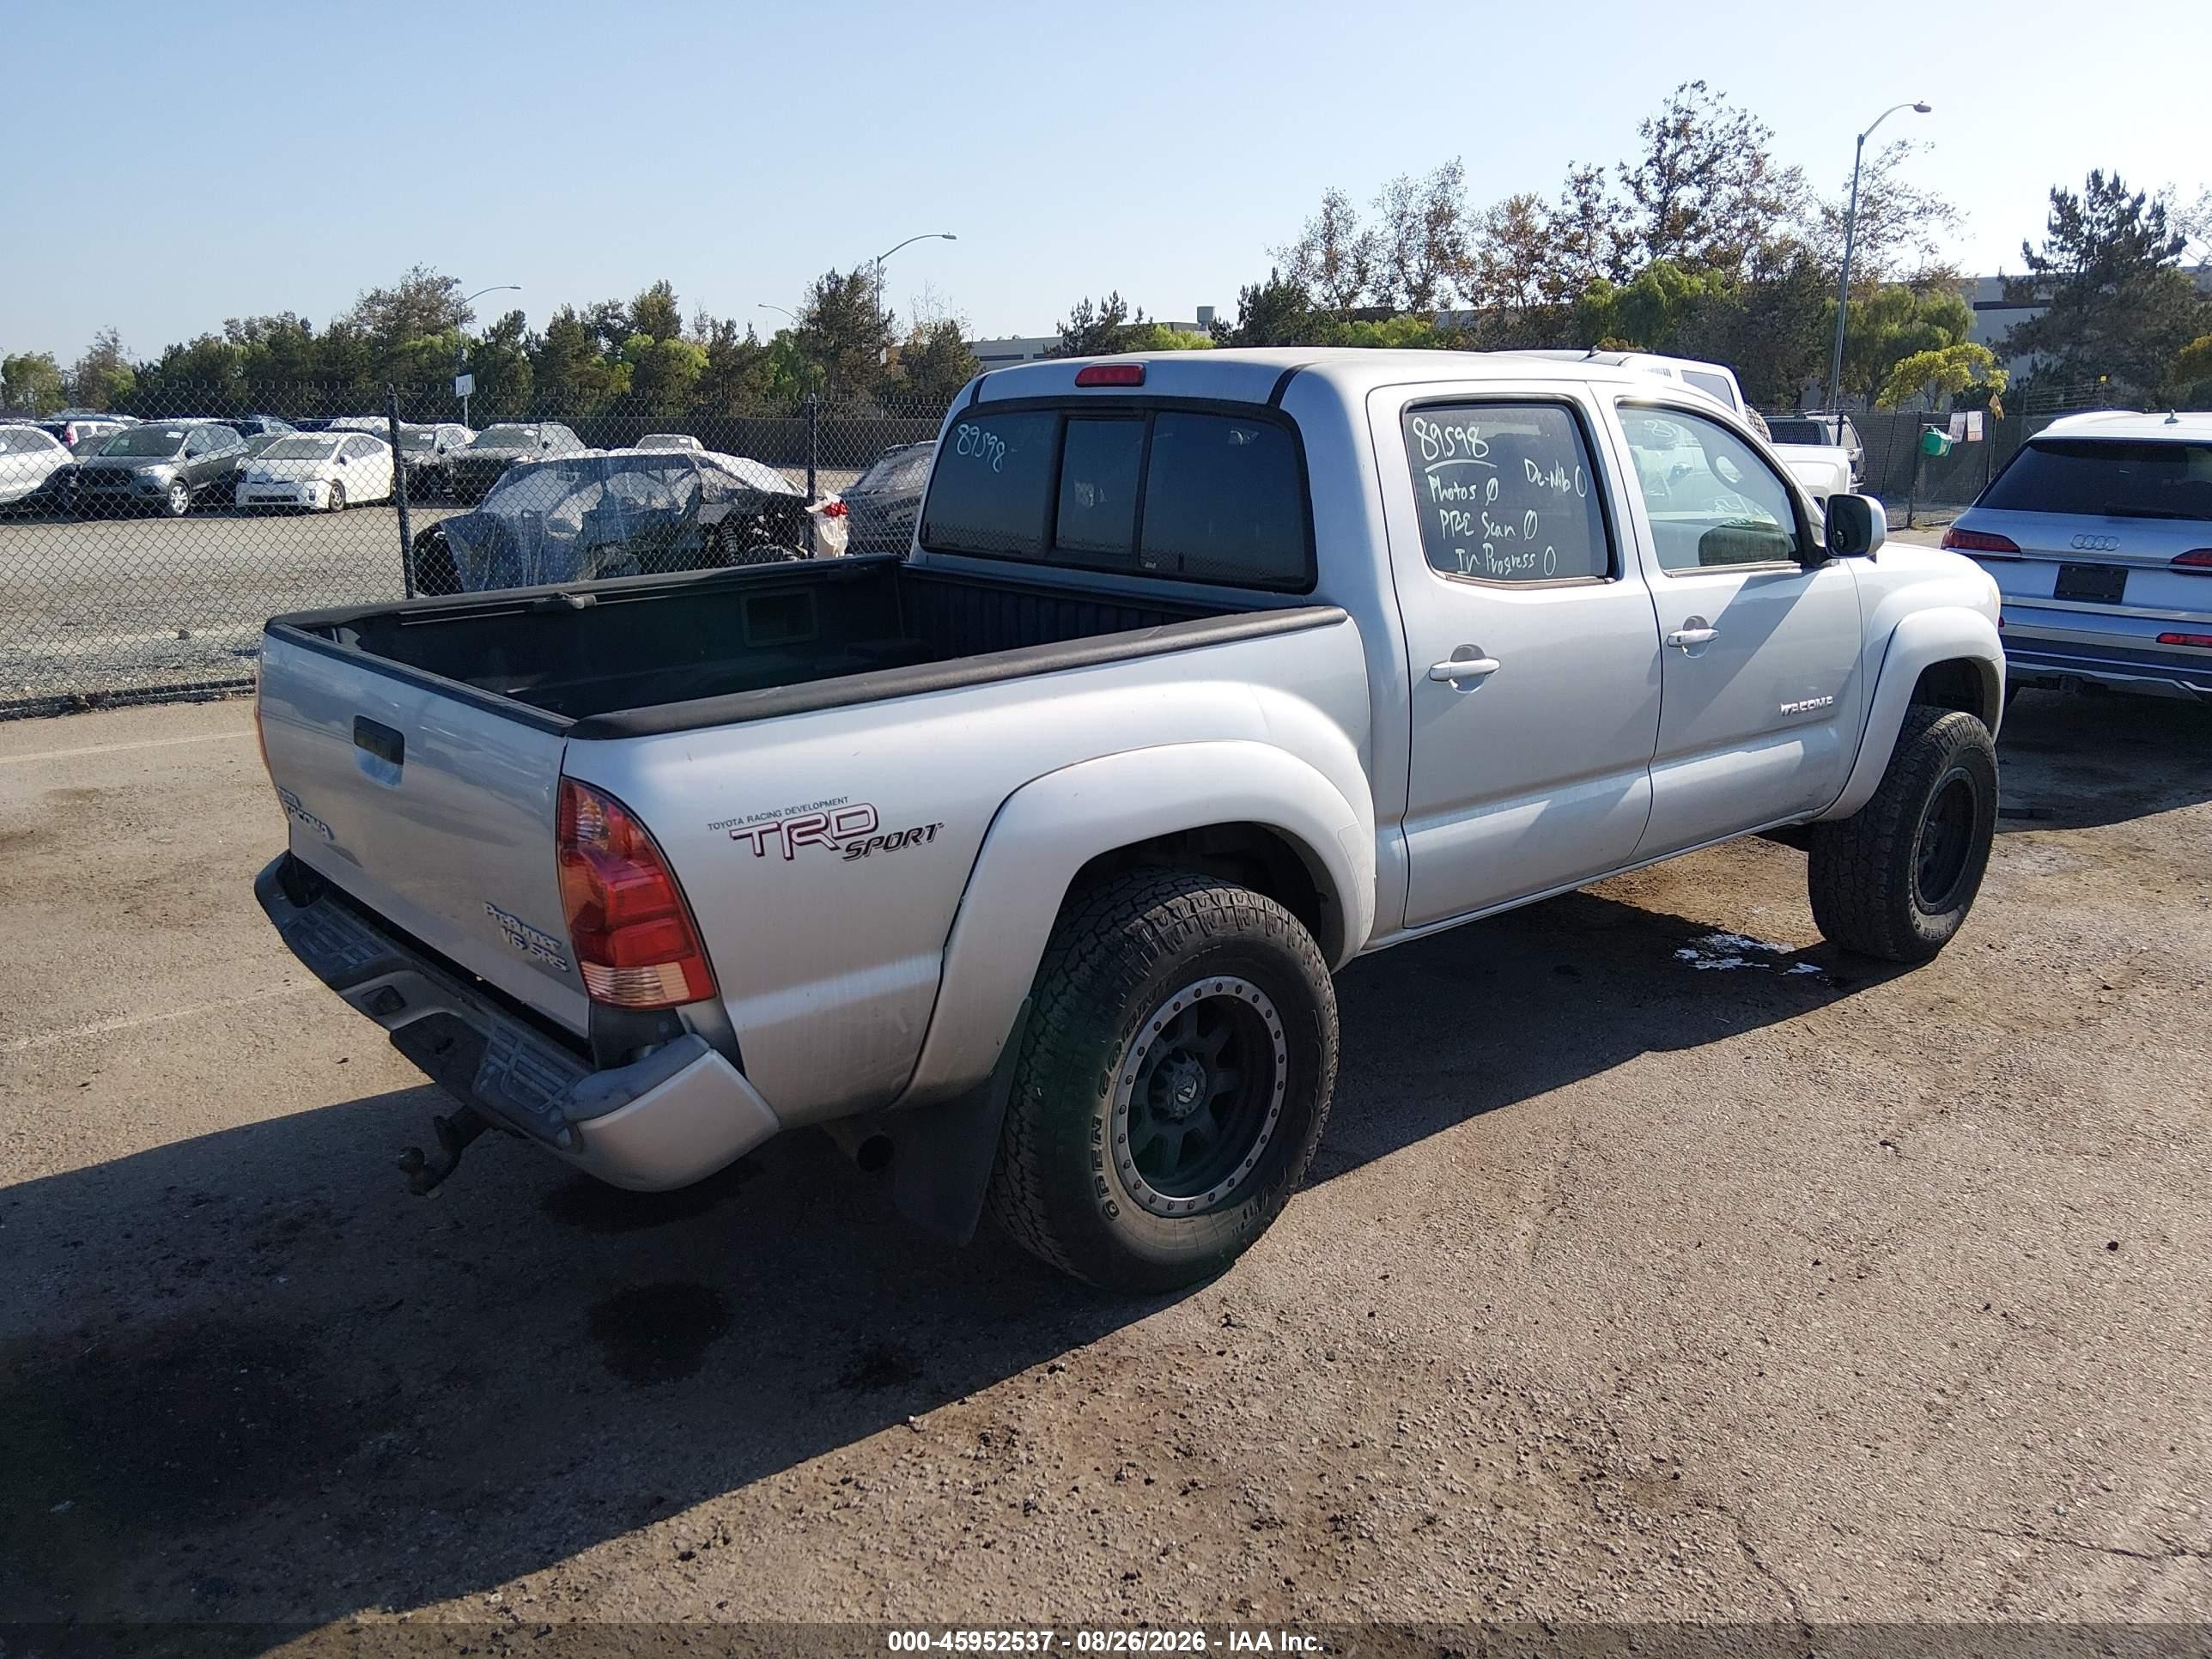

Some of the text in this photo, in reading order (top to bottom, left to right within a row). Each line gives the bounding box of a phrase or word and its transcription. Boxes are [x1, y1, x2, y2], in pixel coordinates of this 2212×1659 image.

[957, 423, 1006, 473] 89598
[1413, 417, 1489, 460] 89598
[1428, 475, 1477, 503] Photos
[1481, 511, 1516, 539] Scan
[1455, 549, 1480, 574] In
[1483, 543, 1536, 575] Progress
[1780, 696, 1833, 715] TACOMA
[708, 796, 849, 831] TOYOTA RACING DEVELOPMENT
[729, 802, 879, 860] TRD
[842, 823, 945, 861] SPORT
[1091, 1115, 1120, 1220] OPEN
